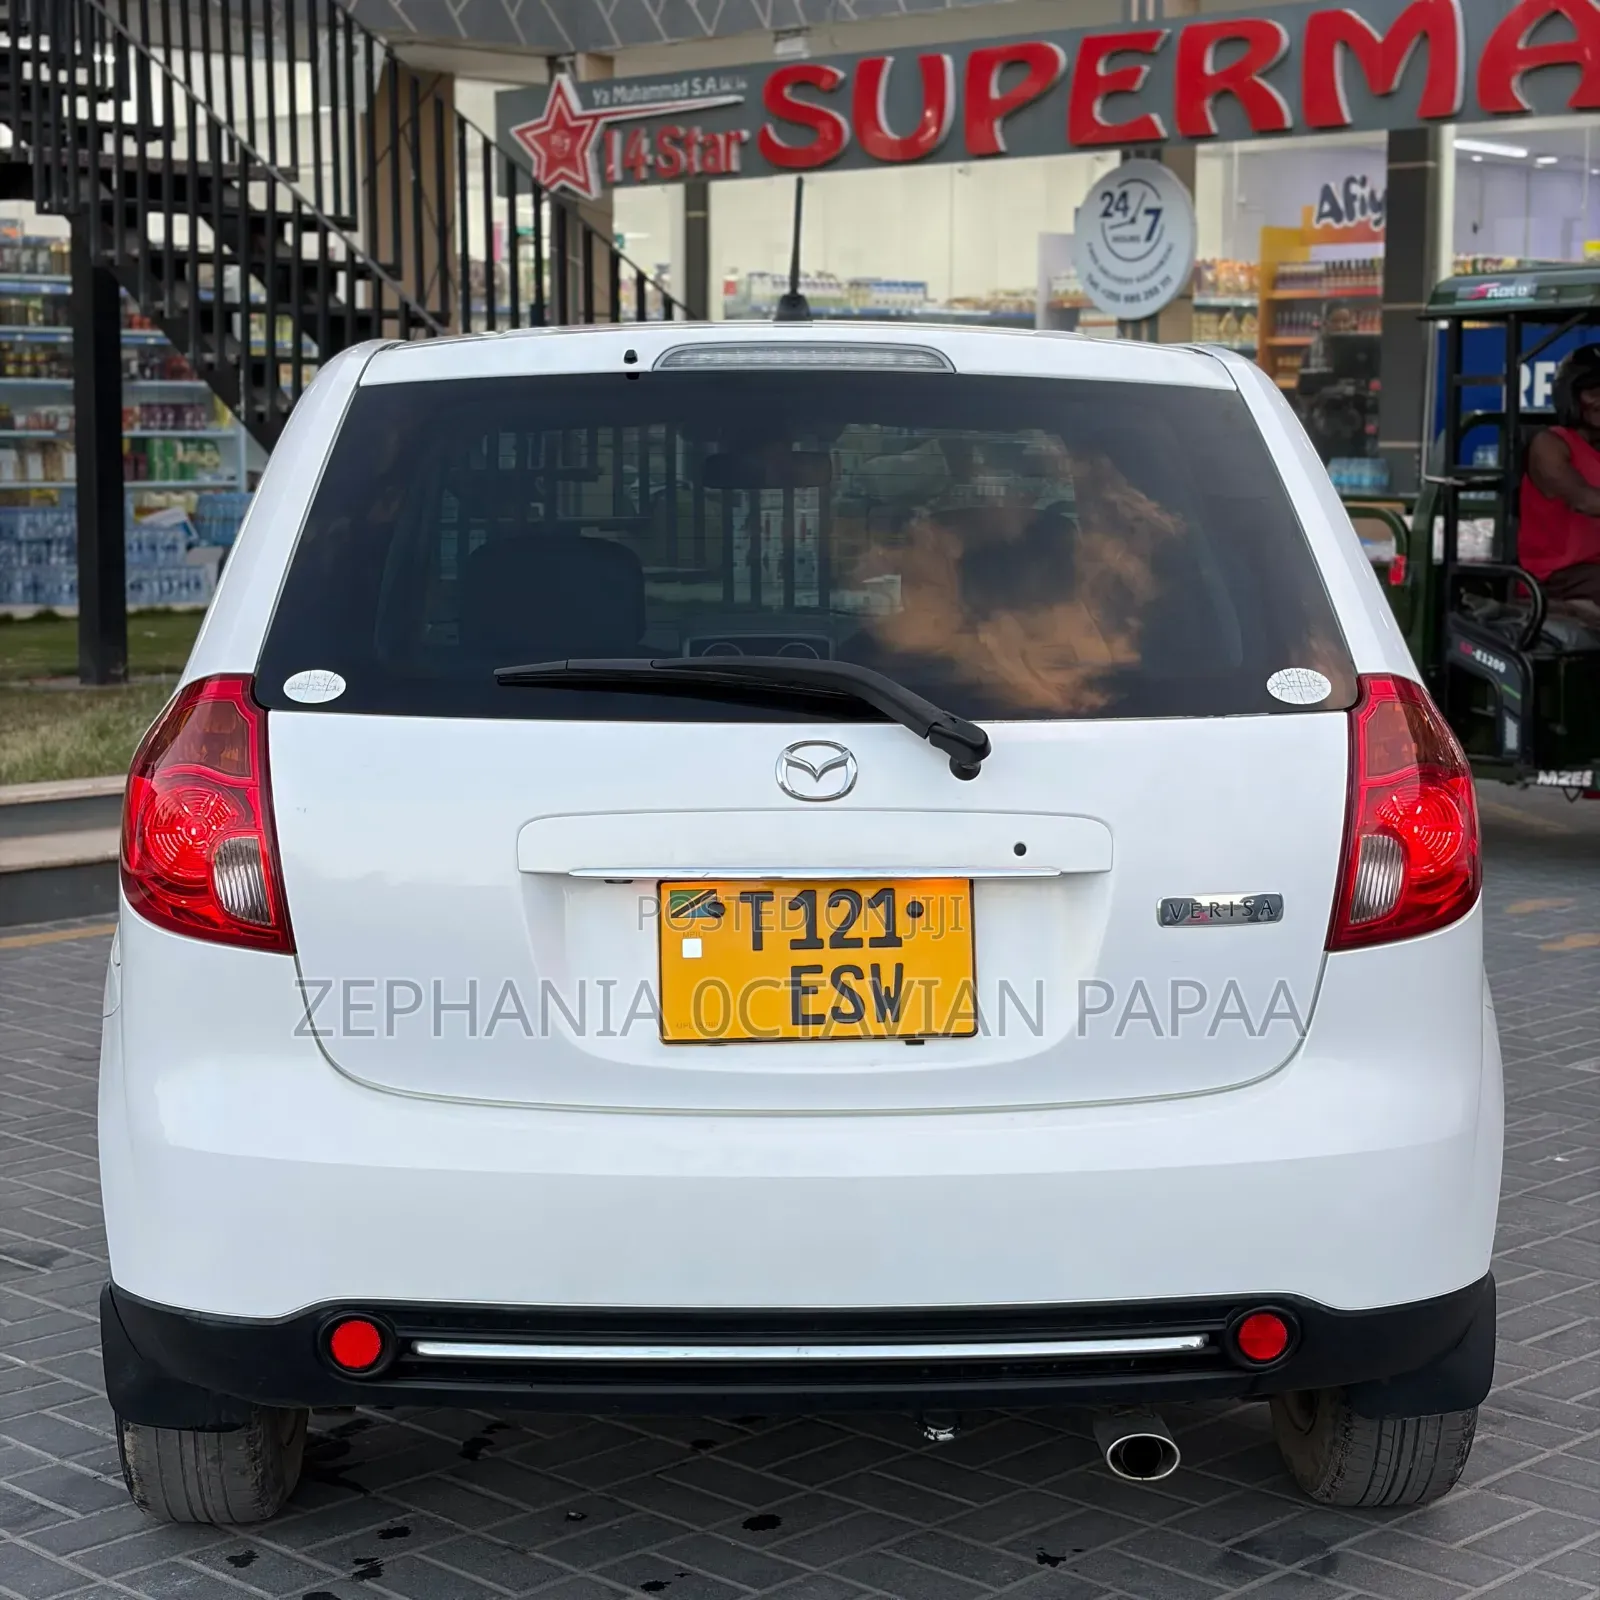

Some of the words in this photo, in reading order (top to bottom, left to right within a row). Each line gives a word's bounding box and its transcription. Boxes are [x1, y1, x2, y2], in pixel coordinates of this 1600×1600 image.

[612, 80, 688, 104] Muhammad
[759, 0, 1600, 167] SUPERMA
[1100, 190, 1130, 218] 24
[1143, 207, 1163, 243] 7
[739, 891, 774, 951] T
[788, 888, 903, 950] 121
[1169, 899, 1274, 920] VERISA
[791, 963, 904, 1026] ESW
